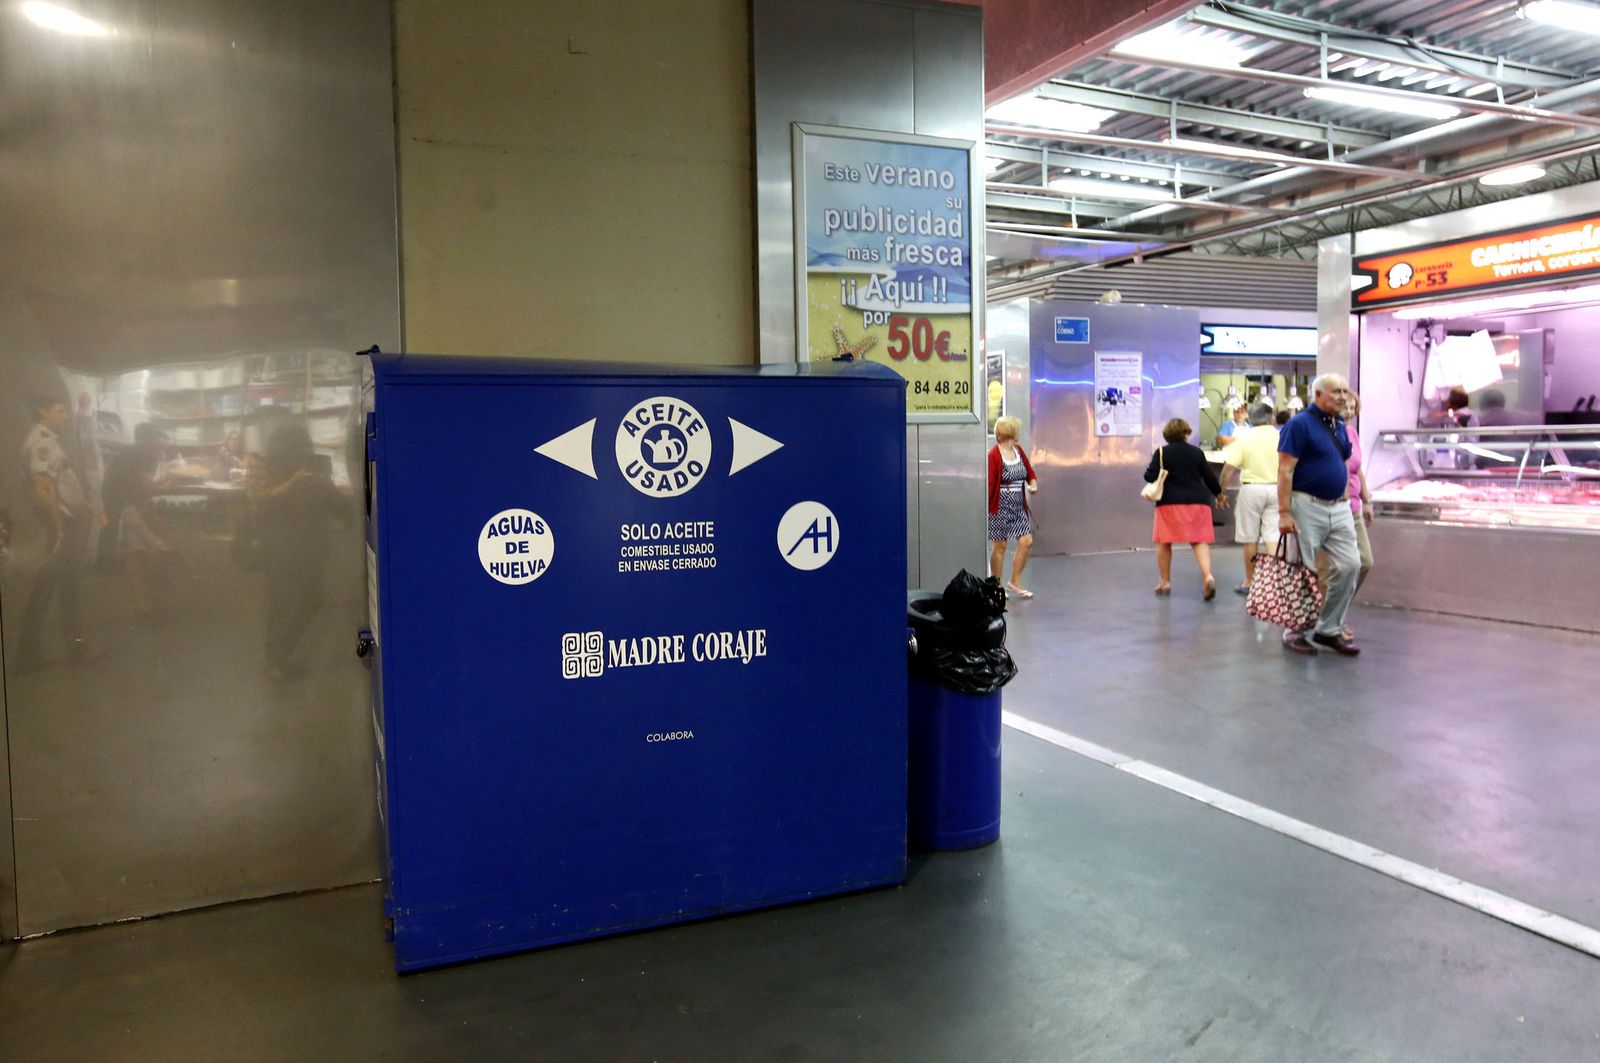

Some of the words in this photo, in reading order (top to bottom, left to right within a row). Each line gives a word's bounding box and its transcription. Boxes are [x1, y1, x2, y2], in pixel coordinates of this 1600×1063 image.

[824, 163, 859, 182] Este
[865, 163, 955, 190] verano
[946, 197, 962, 209] su
[825, 204, 962, 238] publicidad
[847, 245, 879, 262] más
[884, 236, 963, 266] fresca
[865, 273, 923, 308] Aquí
[863, 311, 891, 328] por
[914, 380, 930, 394] 84
[934, 380, 950, 394] 48
[954, 381, 969, 394] 20
[622, 403, 704, 438] ACEITE
[625, 459, 704, 492] USADO
[487, 515, 545, 539] AGUAS
[620, 523, 660, 541] SOLO
[664, 521, 714, 539] ACEITE
[786, 516, 833, 556] AH
[505, 540, 530, 555] DE
[620, 544, 680, 557] COMESTIBLE
[682, 543, 714, 555] USADO
[490, 559, 546, 578] HUELVA
[619, 561, 631, 572] EN
[634, 559, 669, 572] ENVASE
[672, 556, 716, 570] CERRADO
[607, 634, 685, 668] MADRE
[692, 629, 767, 665] CORAJE
[646, 730, 694, 743] COLABORA
